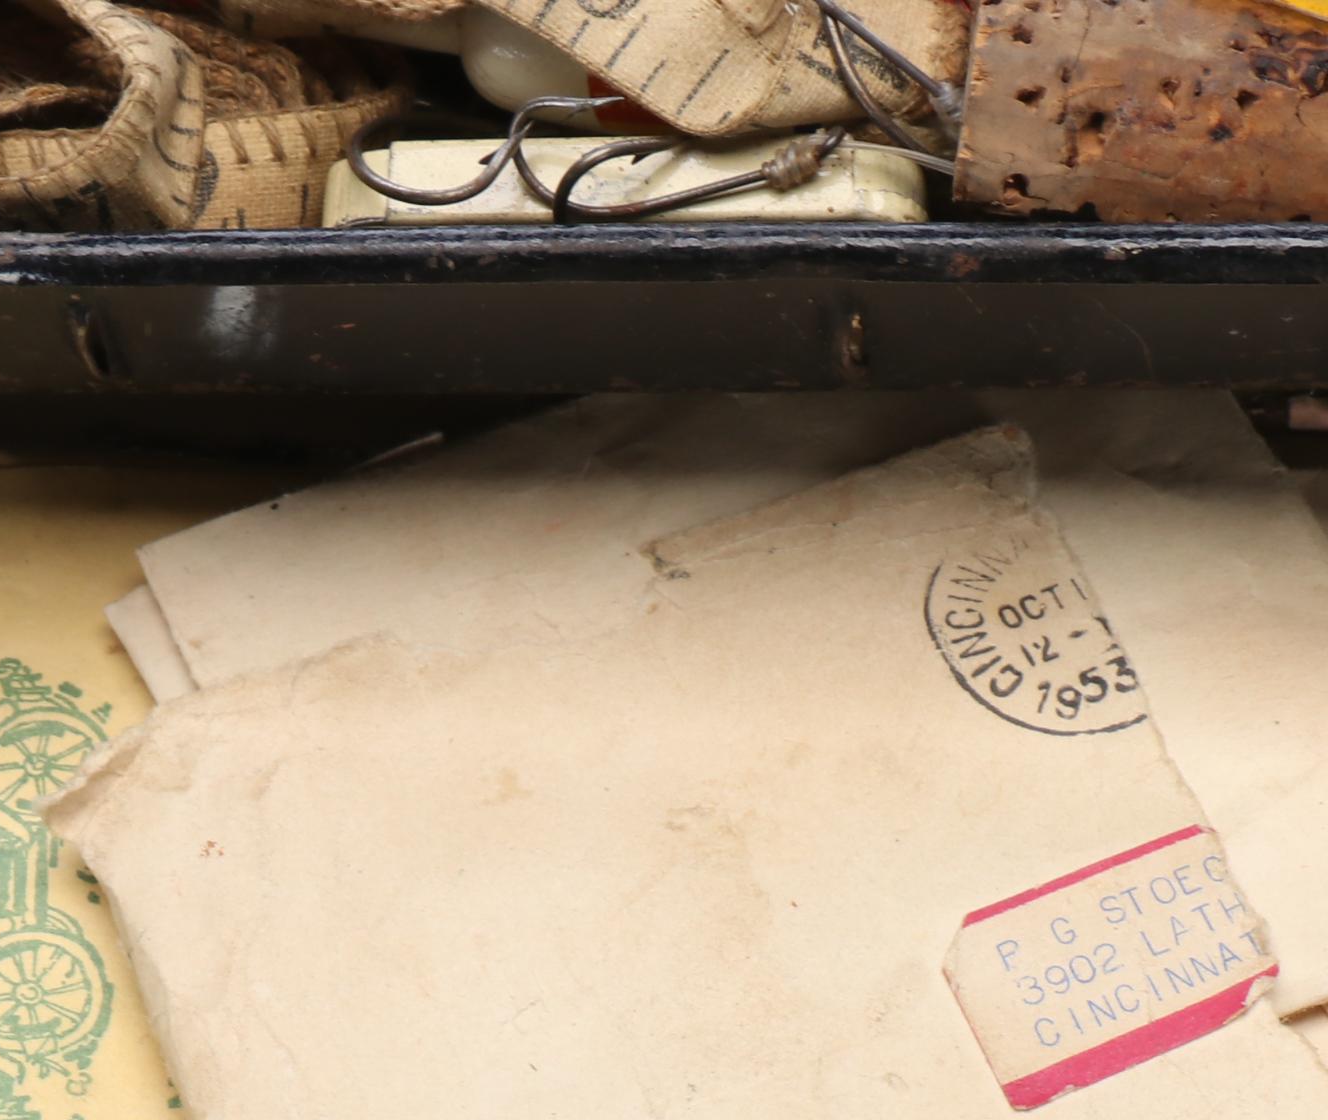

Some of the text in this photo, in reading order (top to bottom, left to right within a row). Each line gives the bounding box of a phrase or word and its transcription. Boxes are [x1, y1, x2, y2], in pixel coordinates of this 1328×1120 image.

[997, 583, 1064, 629] OCT
[1019, 635, 1060, 667] 12
[1037, 655, 1138, 720] 1953
[995, 855, 1225, 972] P G STOEC
[1016, 892, 1249, 1006] 3902 LATH
[1032, 931, 1271, 1048] CINCINNAT
